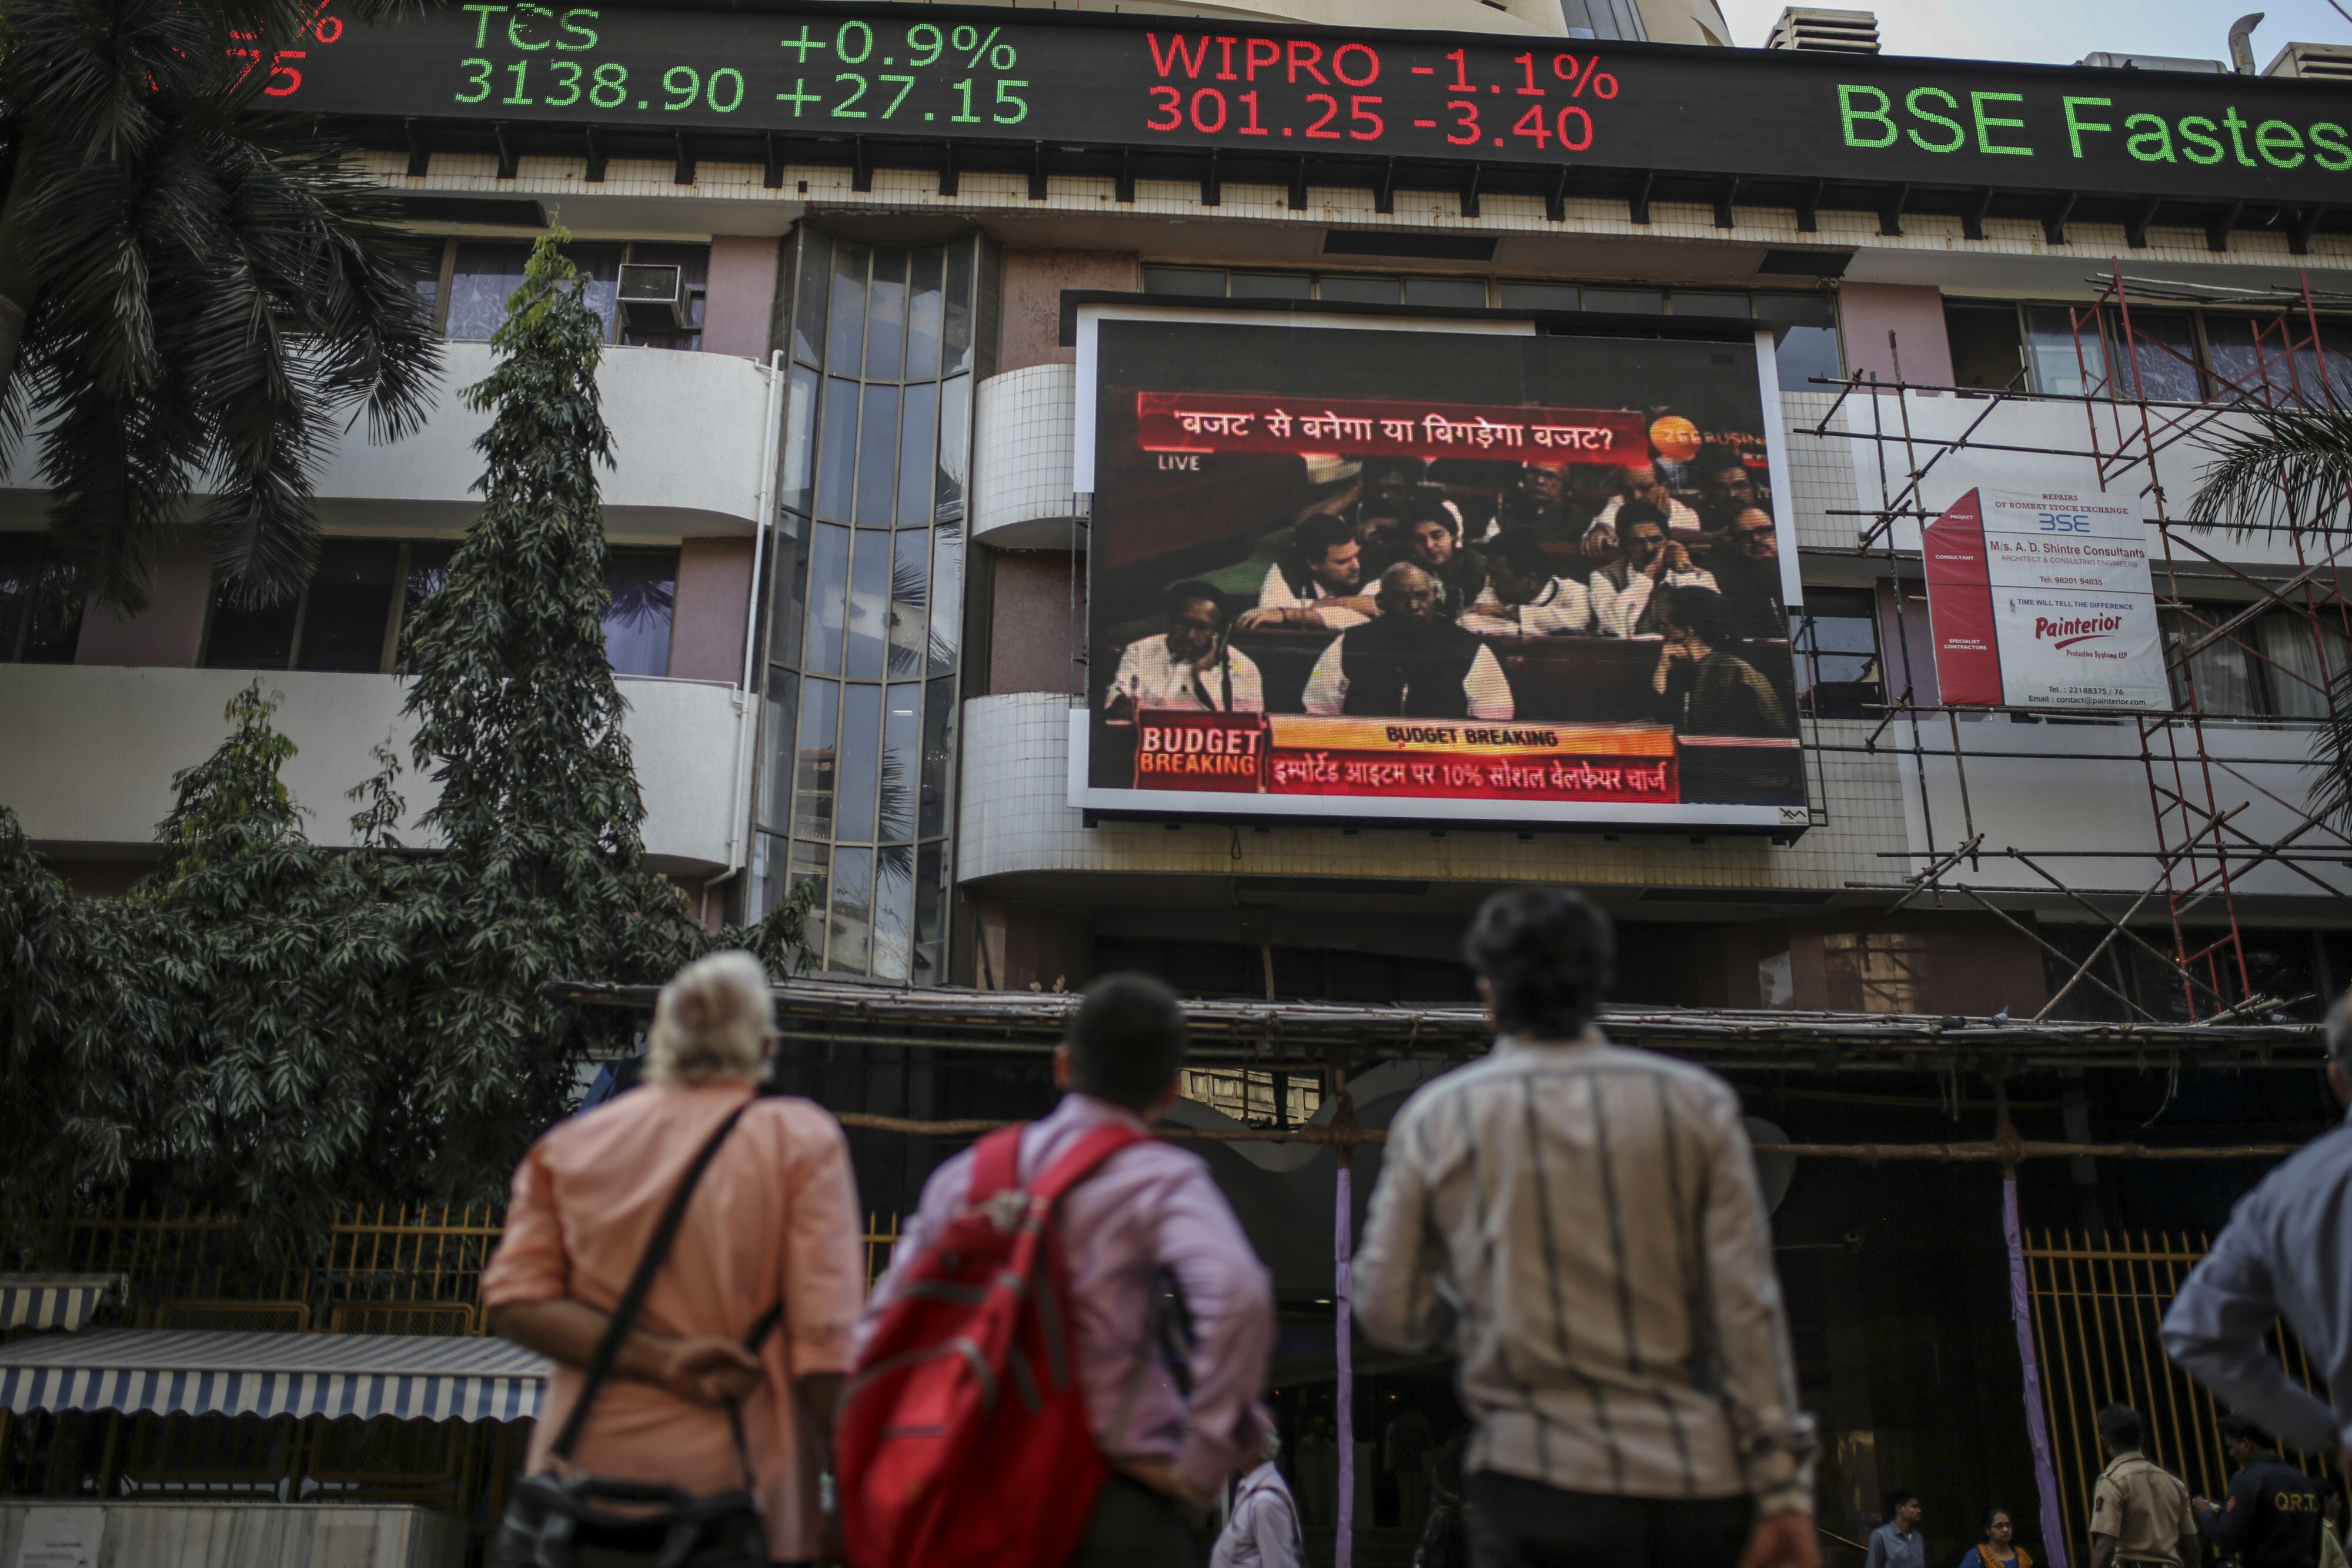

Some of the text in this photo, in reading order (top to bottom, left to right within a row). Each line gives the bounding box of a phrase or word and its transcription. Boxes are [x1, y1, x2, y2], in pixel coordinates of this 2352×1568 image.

[463, 2, 1017, 70] TCS +0.9%
[1147, 33, 1619, 99] WIPRO -1.1%
[455, 58, 1029, 124] 3138.90 +27.15
[1147, 85, 1614, 151] 301.25 -3.40
[1837, 83, 2352, 171] BSE Fastes
[1264, 408, 1292, 438] से
[1299, 410, 1374, 441] बनेगा
[1380, 419, 1415, 442] या
[1158, 454, 1200, 471] LIVE
[2081, 506, 2129, 514] EXCHANGE
[2039, 513, 2090, 533] BSE
[1990, 540, 2145, 558] M/s. A. D. Shintre Consultants
[2050, 557, 2096, 566] CONSULTING
[2090, 602, 2134, 610] DIFFERENCE
[2035, 612, 2122, 640] Painterior
[2066, 650, 2093, 658] Protective
[2094, 651, 2117, 660] Systems
[2056, 697, 2146, 706] contact@painterior.com
[1142, 727, 1261, 755] BUDGET
[1386, 726, 1559, 747] BUDGET BREAKING
[1140, 753, 1255, 776] BREAKING
[1345, 760, 1406, 787] आइटम
[1411, 763, 1436, 786] पर
[1442, 764, 1483, 788] 10%
[1488, 758, 1546, 789] सोशल
